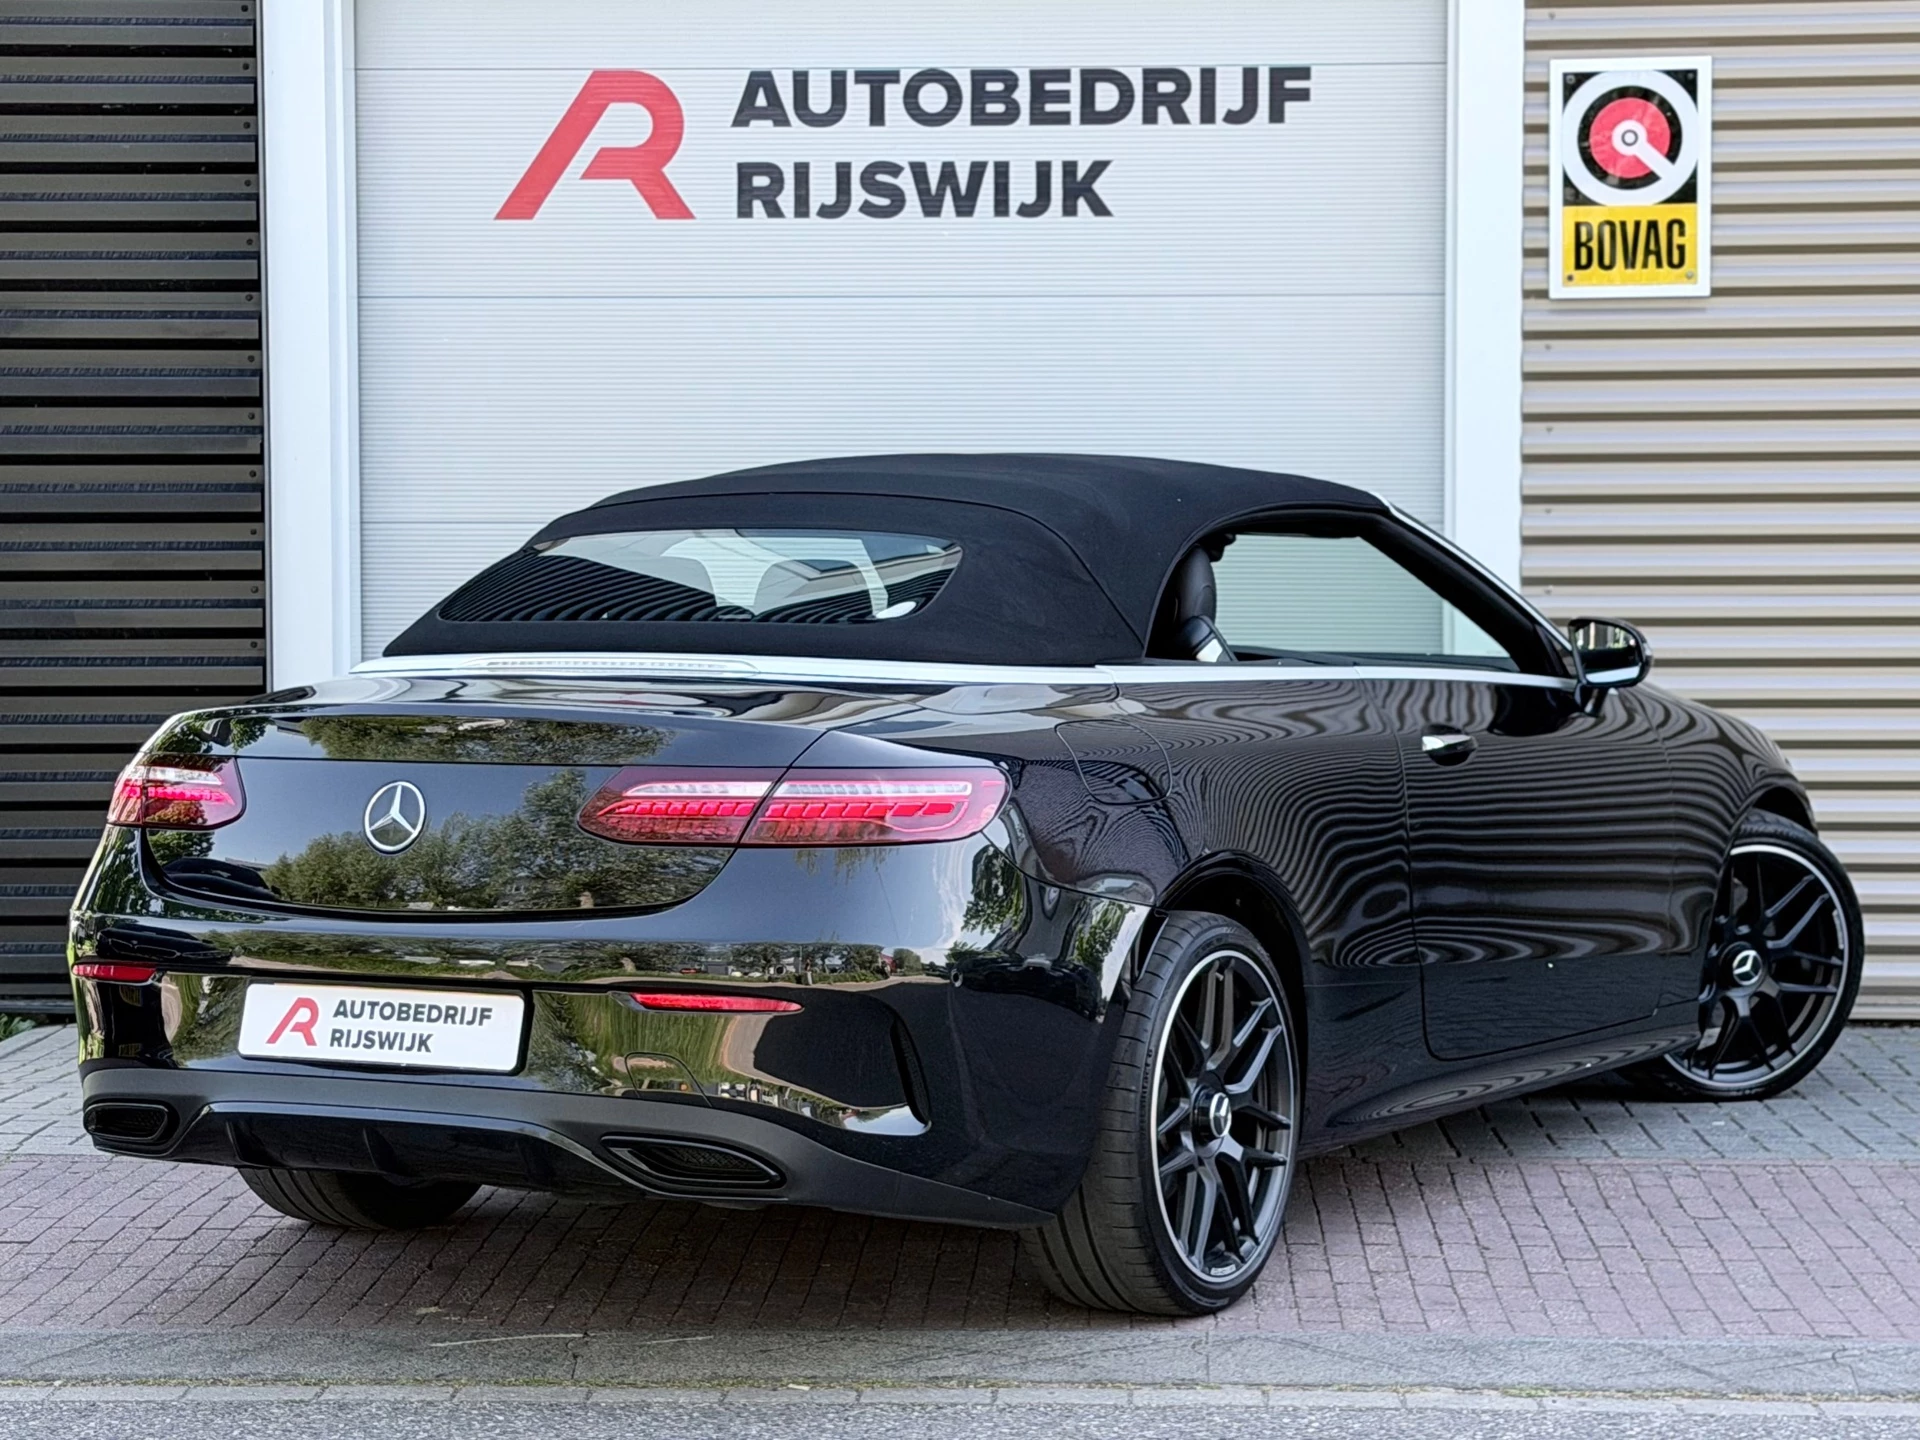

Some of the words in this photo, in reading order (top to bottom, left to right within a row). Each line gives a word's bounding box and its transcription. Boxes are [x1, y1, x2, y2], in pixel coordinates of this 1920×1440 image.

[732, 66, 1312, 127] AUTOBEDRIJF
[736, 160, 1113, 219] RIJSWIJK
[1574, 218, 1686, 271] BOVAG
[333, 999, 493, 1027] AUTOBEDRIJF
[330, 1028, 434, 1053] RIJSWIJK
